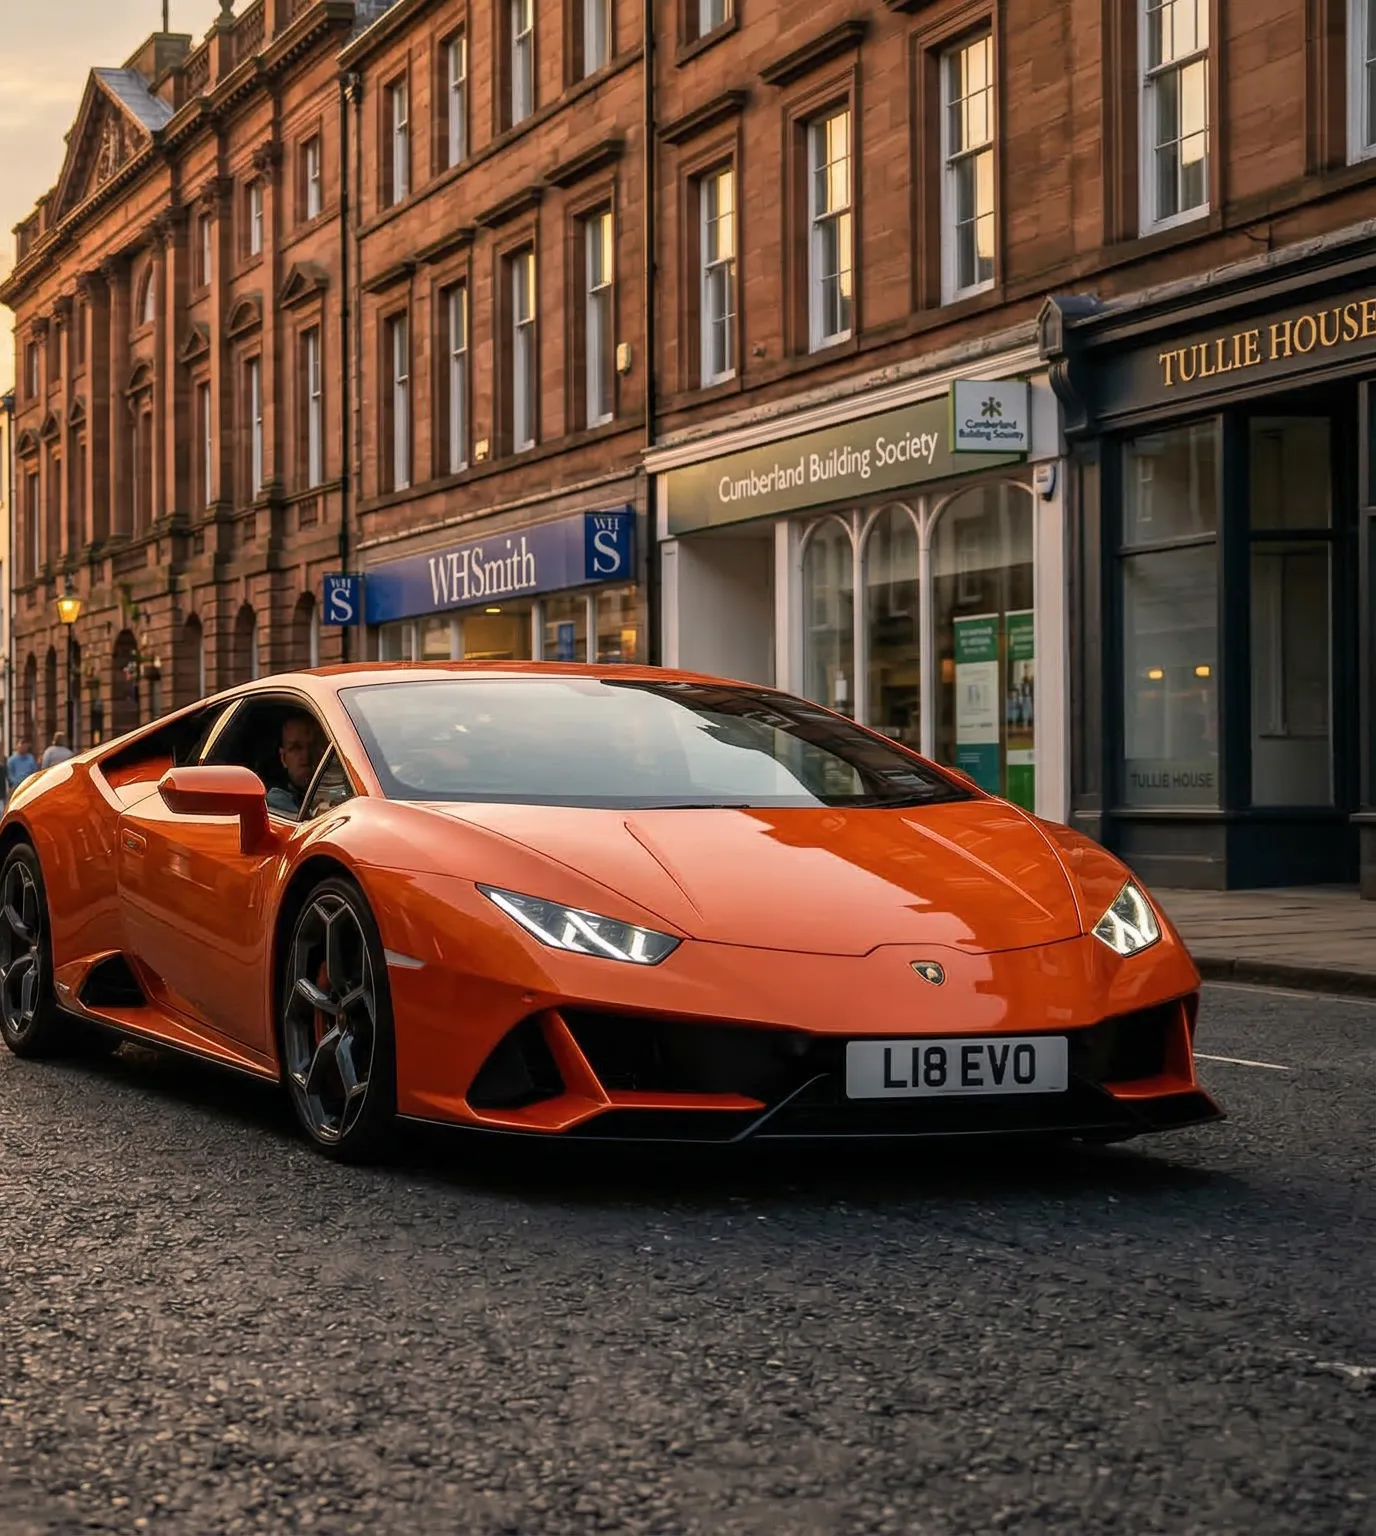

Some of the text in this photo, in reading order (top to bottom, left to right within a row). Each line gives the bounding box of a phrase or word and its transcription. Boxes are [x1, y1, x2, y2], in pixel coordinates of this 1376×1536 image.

[1158, 298, 1376, 386] TULLIE HOUSE
[719, 431, 939, 503] Cumberland Building Society
[593, 517, 620, 531] WH
[428, 537, 536, 605] WHSmith
[593, 530, 621, 573] S
[330, 587, 353, 622] S
[1130, 772, 1215, 788] TULLIE HOUSE
[961, 1044, 1036, 1086] EVO
